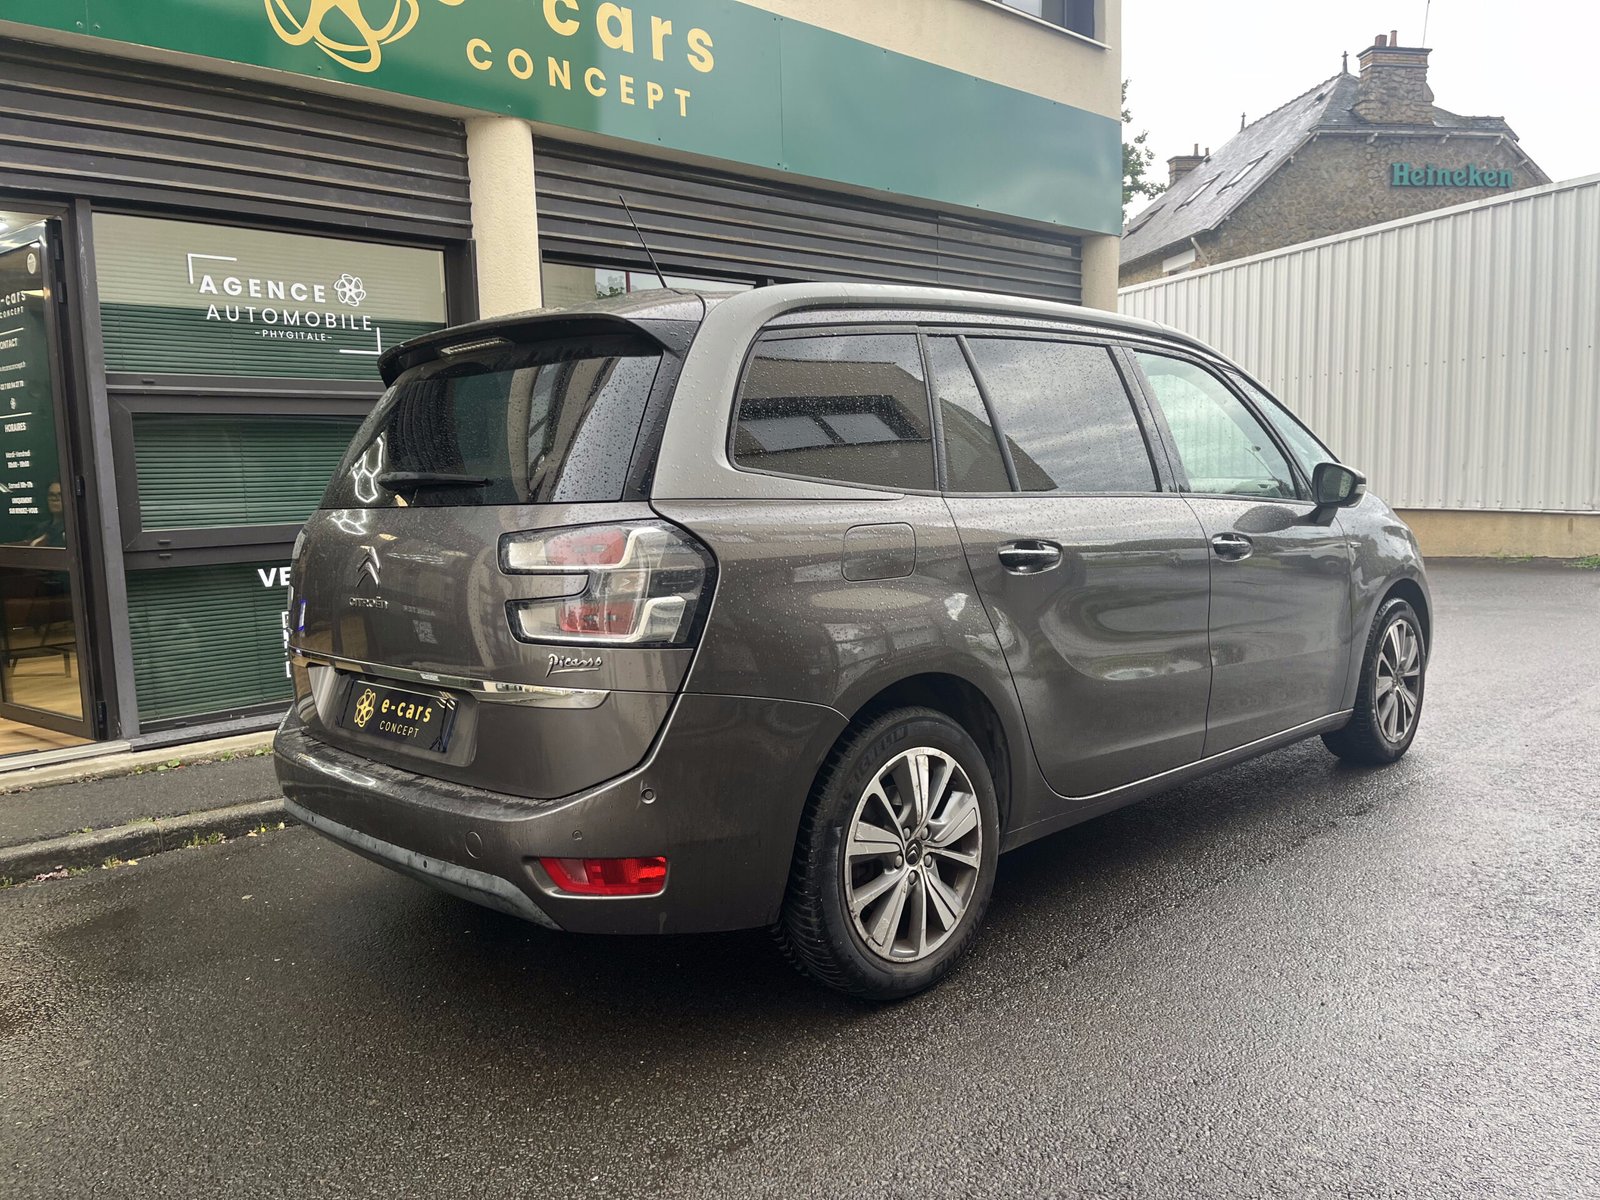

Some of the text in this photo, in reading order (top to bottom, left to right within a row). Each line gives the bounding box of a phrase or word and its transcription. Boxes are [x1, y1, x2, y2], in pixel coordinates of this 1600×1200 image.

[466, 38, 691, 118] CONCEPT
[1391, 162, 1513, 188] Heineken
[199, 275, 326, 303] AGENCE
[206, 304, 372, 331] AUTOMOBILE
[0, 337, 18, 350] ONTACT
[545, 653, 603, 679] Picasso
[381, 699, 433, 723] e-cars
[379, 720, 420, 738] CONCEPT
